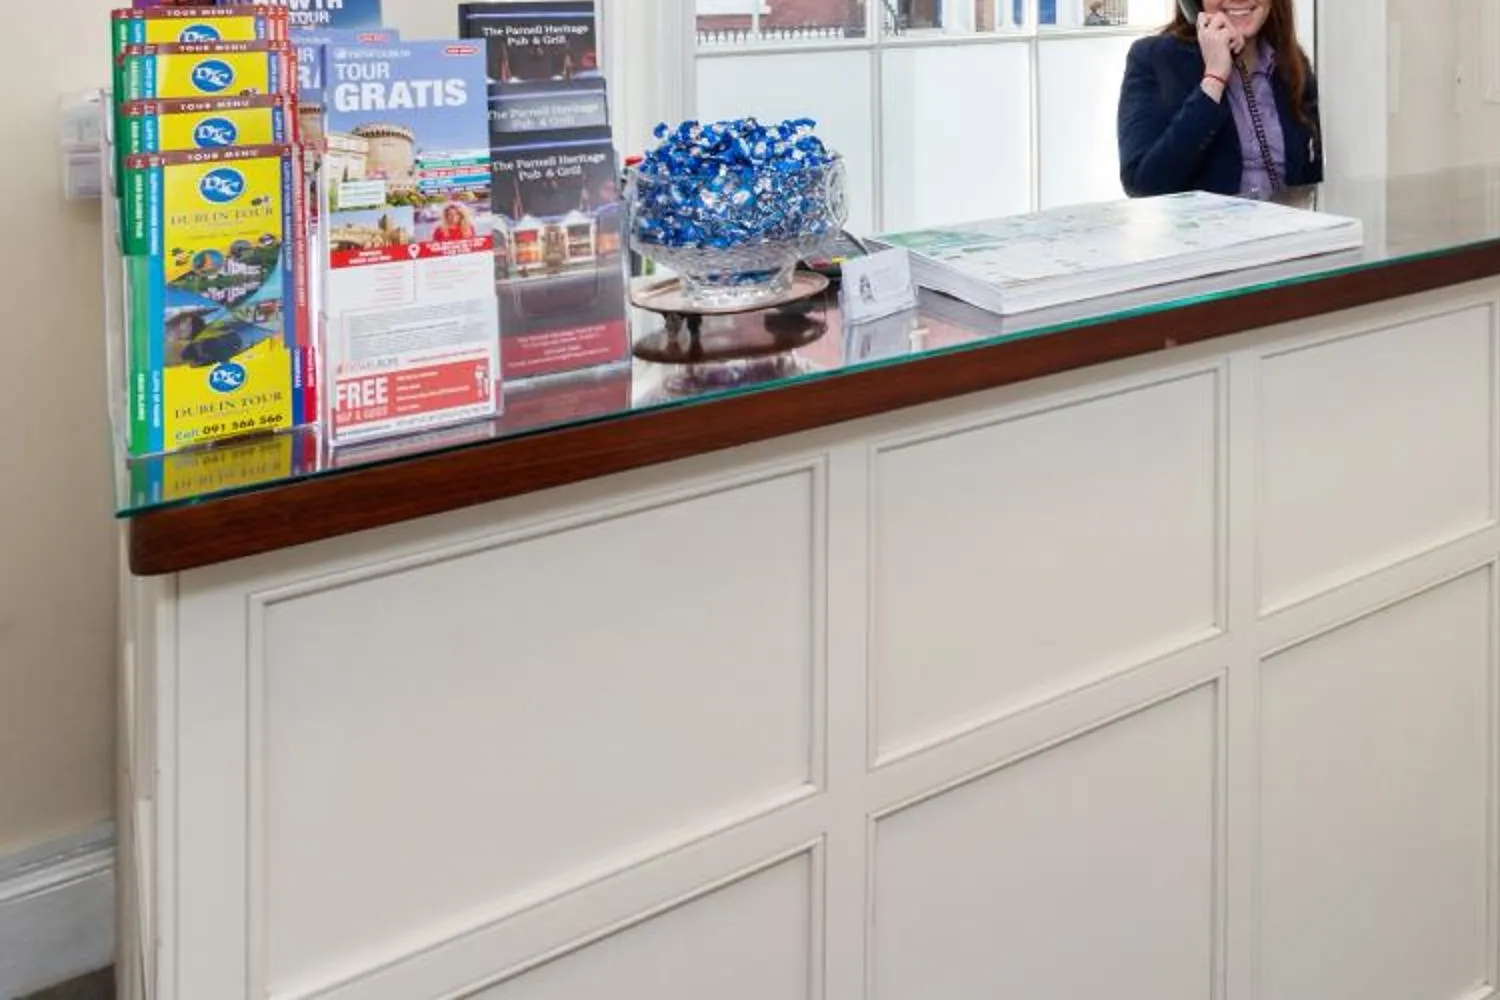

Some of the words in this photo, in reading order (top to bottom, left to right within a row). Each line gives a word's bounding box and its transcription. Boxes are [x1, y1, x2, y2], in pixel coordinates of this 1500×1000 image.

[201, 7, 234, 16] MENU
[289, 11, 329, 25] TOUR
[483, 27, 504, 36] The
[545, 24, 589, 35] Heritage
[507, 37, 528, 46] Pub
[532, 37, 540, 45] &
[543, 35, 566, 45] Grill
[180, 44, 210, 53] TOUR
[216, 43, 247, 51] MENU
[335, 62, 390, 81] TOUR
[335, 78, 467, 112] GRATIS
[180, 103, 211, 111] TOUR
[217, 100, 249, 109] MENU
[187, 152, 217, 161] TOUR
[224, 149, 257, 158] MENU
[493, 162, 514, 172] The
[516, 157, 557, 169] Parnell
[558, 153, 606, 165] Heritage
[518, 170, 541, 181] Pub
[546, 168, 554, 177] &
[556, 165, 581, 176] Grill
[170, 210, 230, 227] DUBLIN
[235, 206, 274, 221] TOUR
[336, 377, 388, 411] FREE
[175, 400, 237, 419] DUBLIN
[242, 391, 284, 409] TOUR
[202, 422, 227, 436] 091
